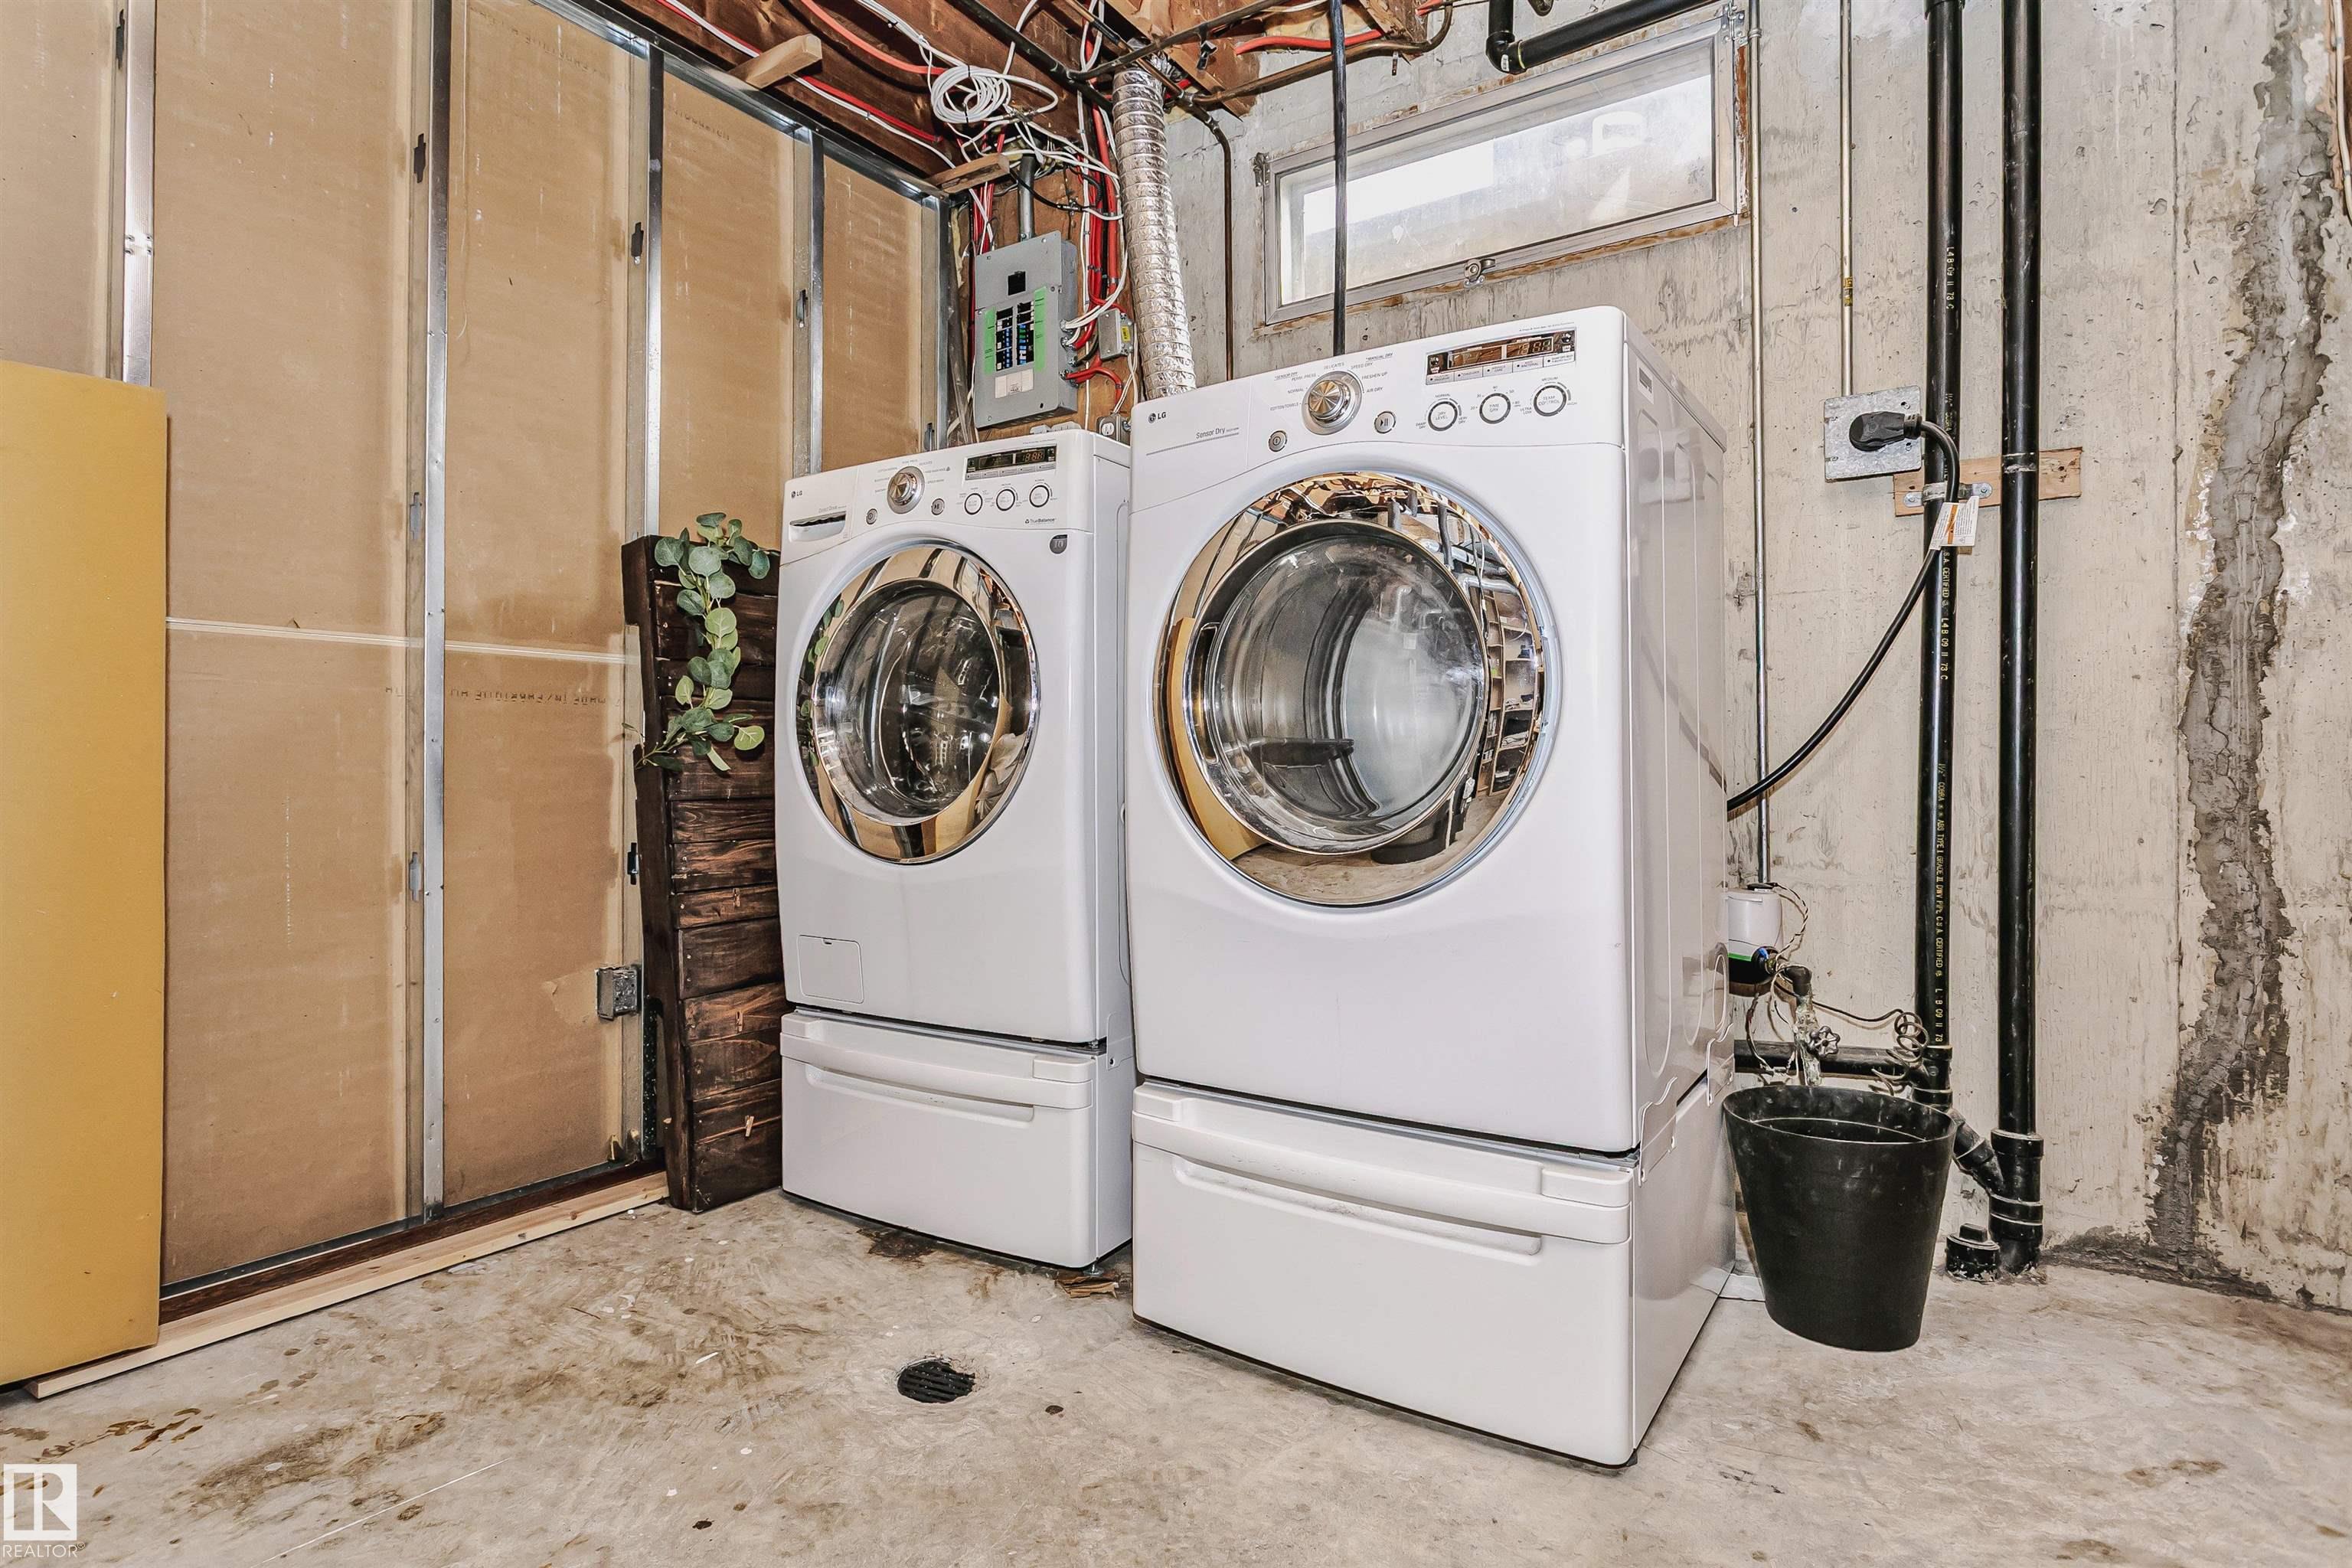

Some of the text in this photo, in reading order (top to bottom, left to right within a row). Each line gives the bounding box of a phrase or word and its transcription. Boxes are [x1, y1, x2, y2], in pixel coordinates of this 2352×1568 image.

[1946, 292, 1954, 300] 73
[1158, 412, 1167, 420] LG
[1196, 430, 1214, 439] Sensor
[1942, 567, 1950, 598] CERTIFIED
[1941, 638, 1949, 647] 09
[1940, 662, 1948, 671] 73
[1935, 1009, 1943, 1018] 09
[1936, 1034, 1943, 1042] 73
